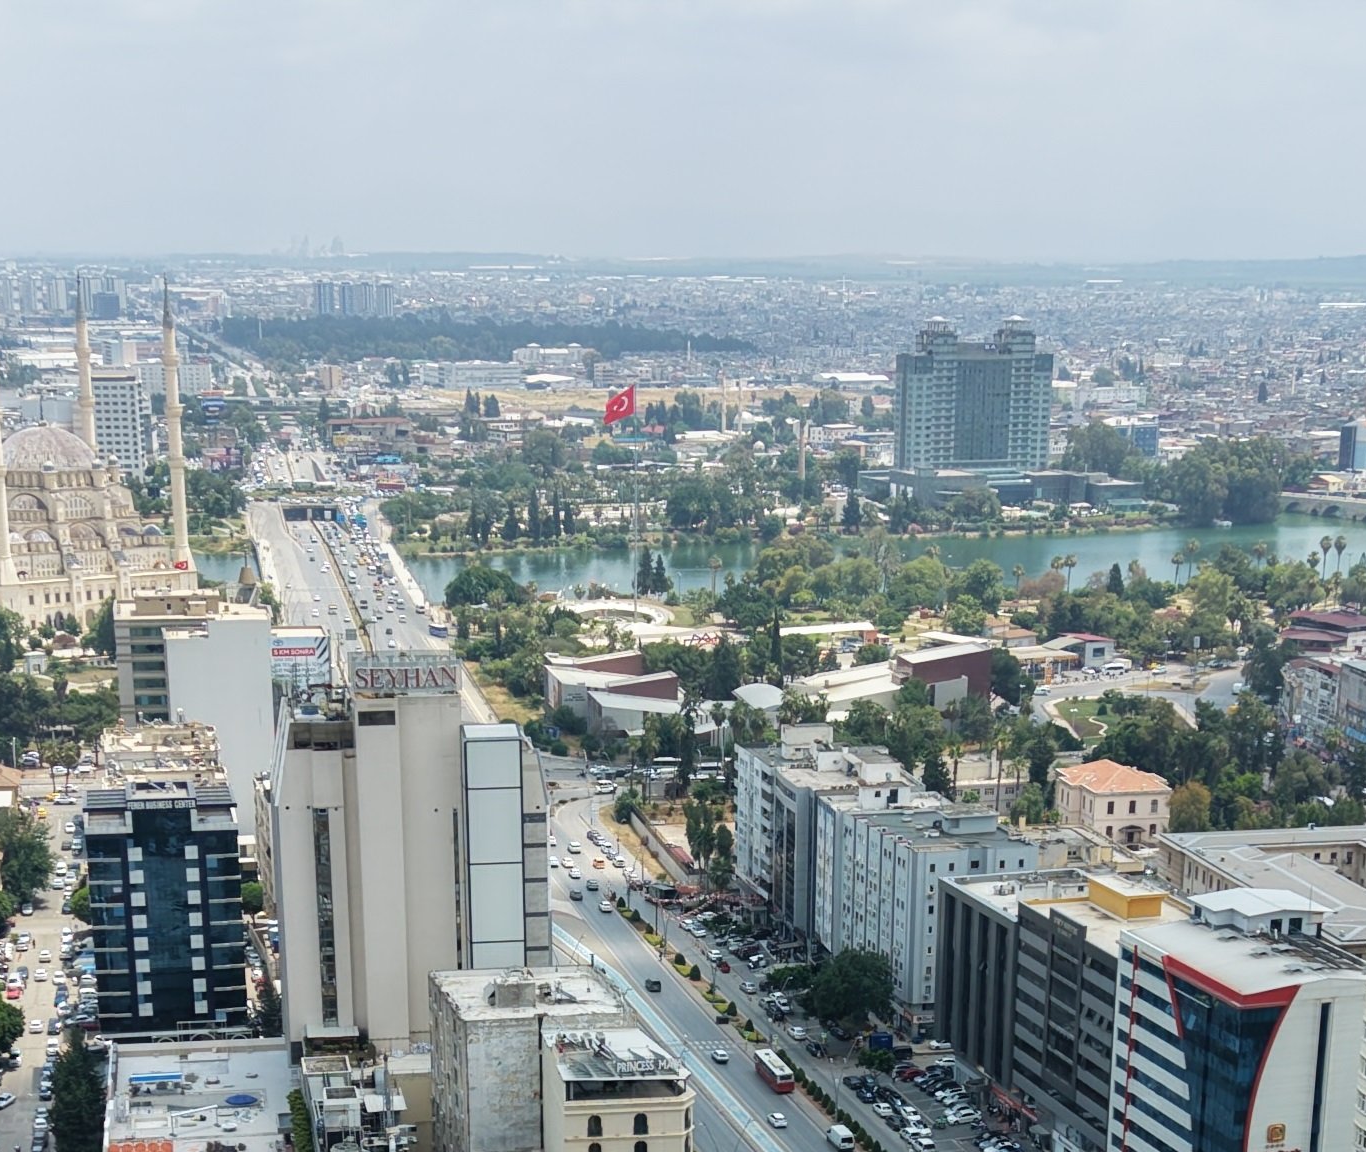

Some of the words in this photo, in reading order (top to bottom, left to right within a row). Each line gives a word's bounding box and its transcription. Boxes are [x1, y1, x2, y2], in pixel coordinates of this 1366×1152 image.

[355, 664, 457, 689] SEYHAN
[145, 800, 173, 809] BUSINESS
[174, 799, 196, 808] CENTER
[616, 1060, 654, 1073] PRINCESS
